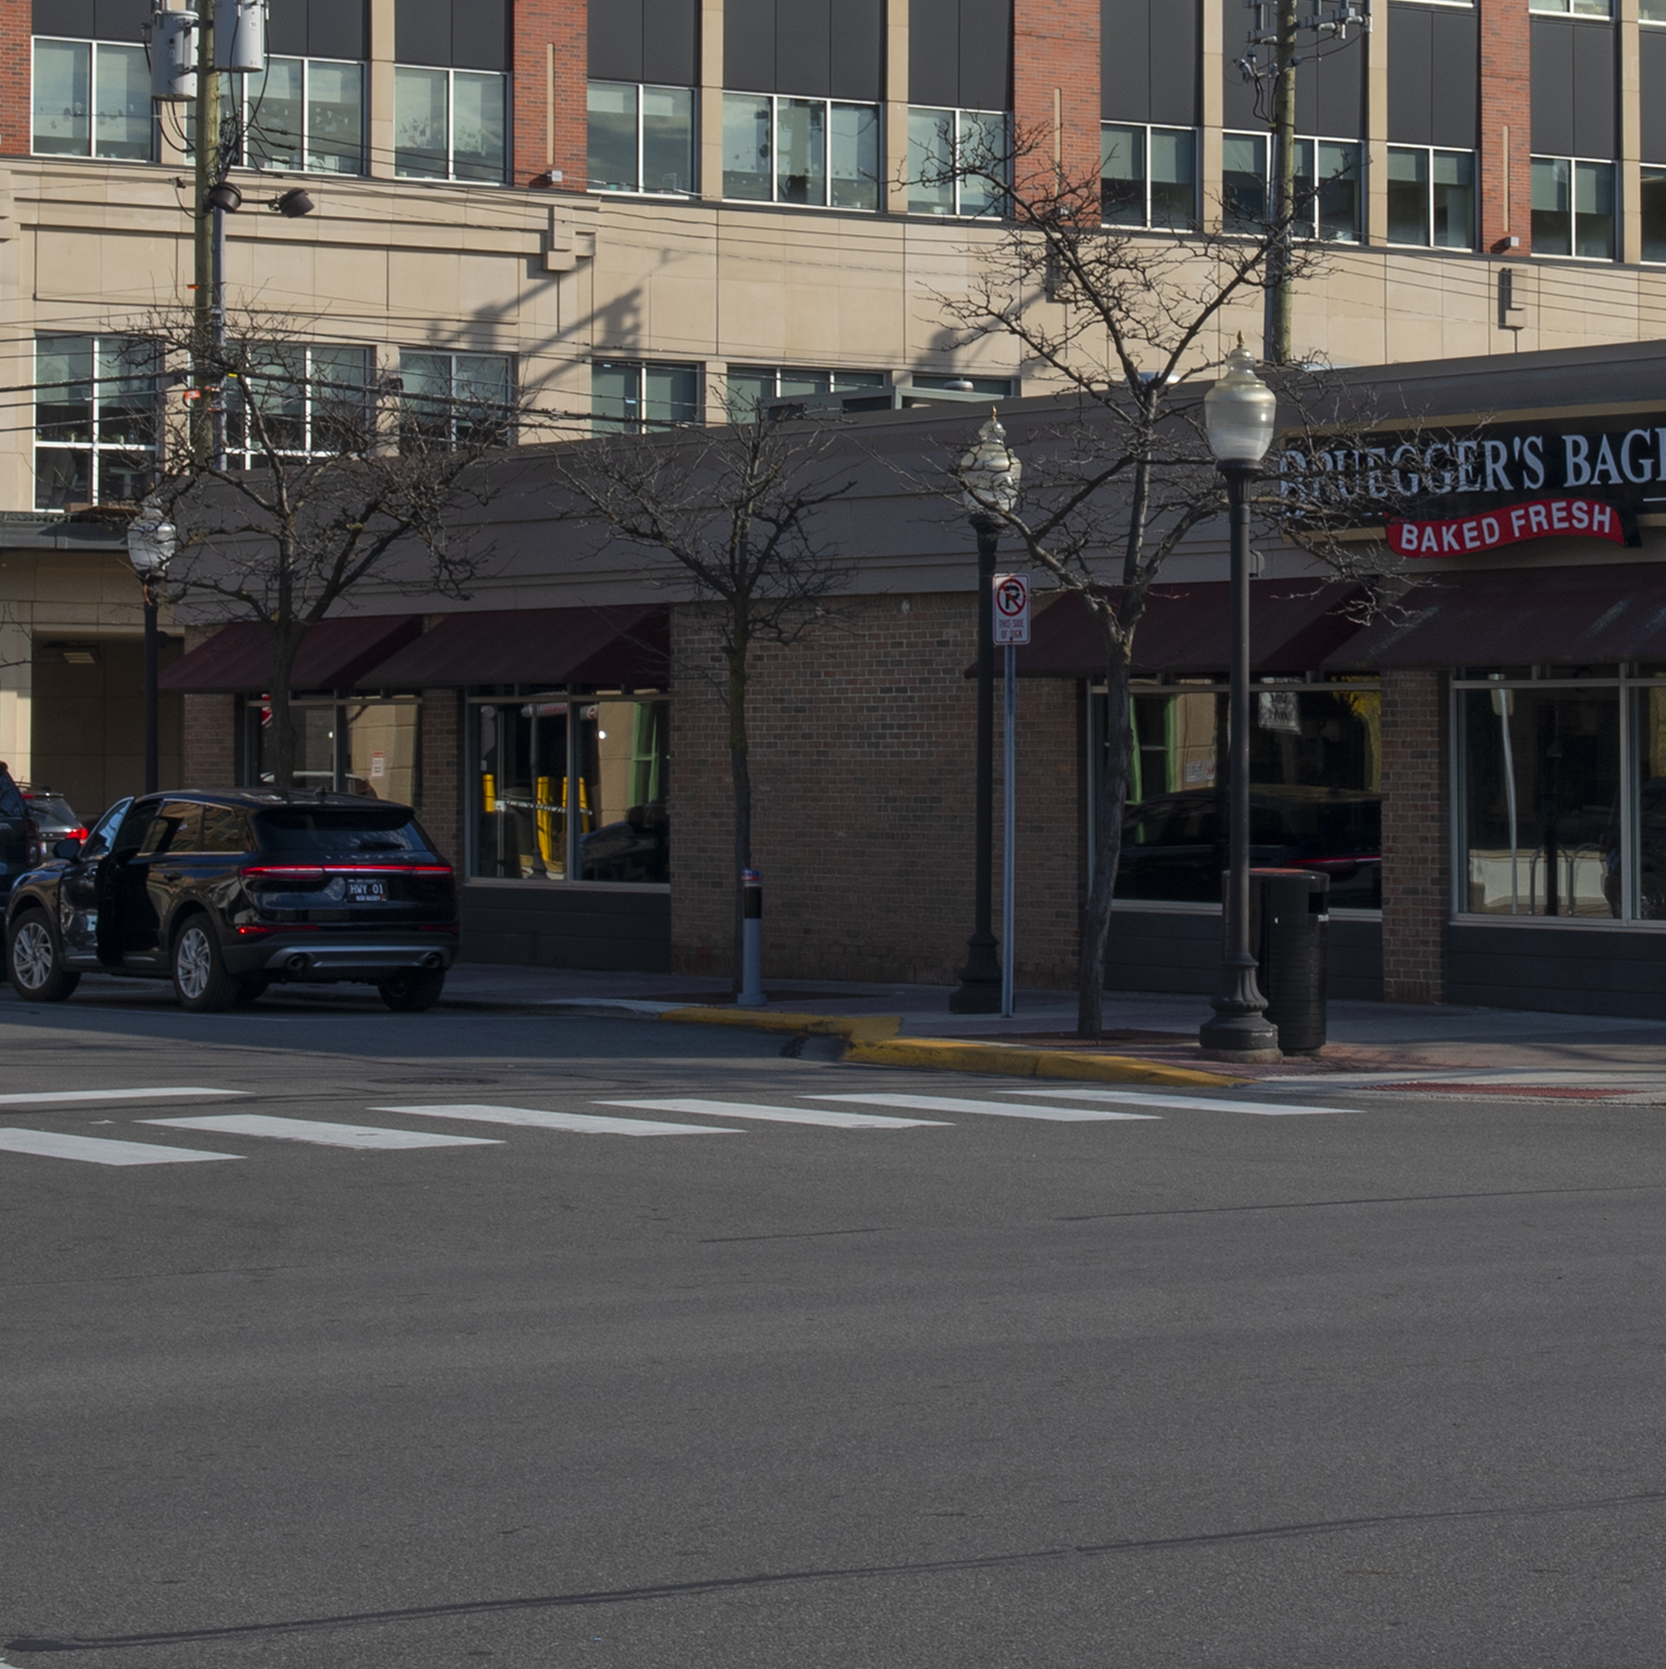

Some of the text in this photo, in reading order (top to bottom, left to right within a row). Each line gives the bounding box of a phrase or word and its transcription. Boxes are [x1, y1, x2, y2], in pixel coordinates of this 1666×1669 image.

[1400, 498, 1614, 553] BAKED FRESH
[350, 884, 367, 894] HWY
